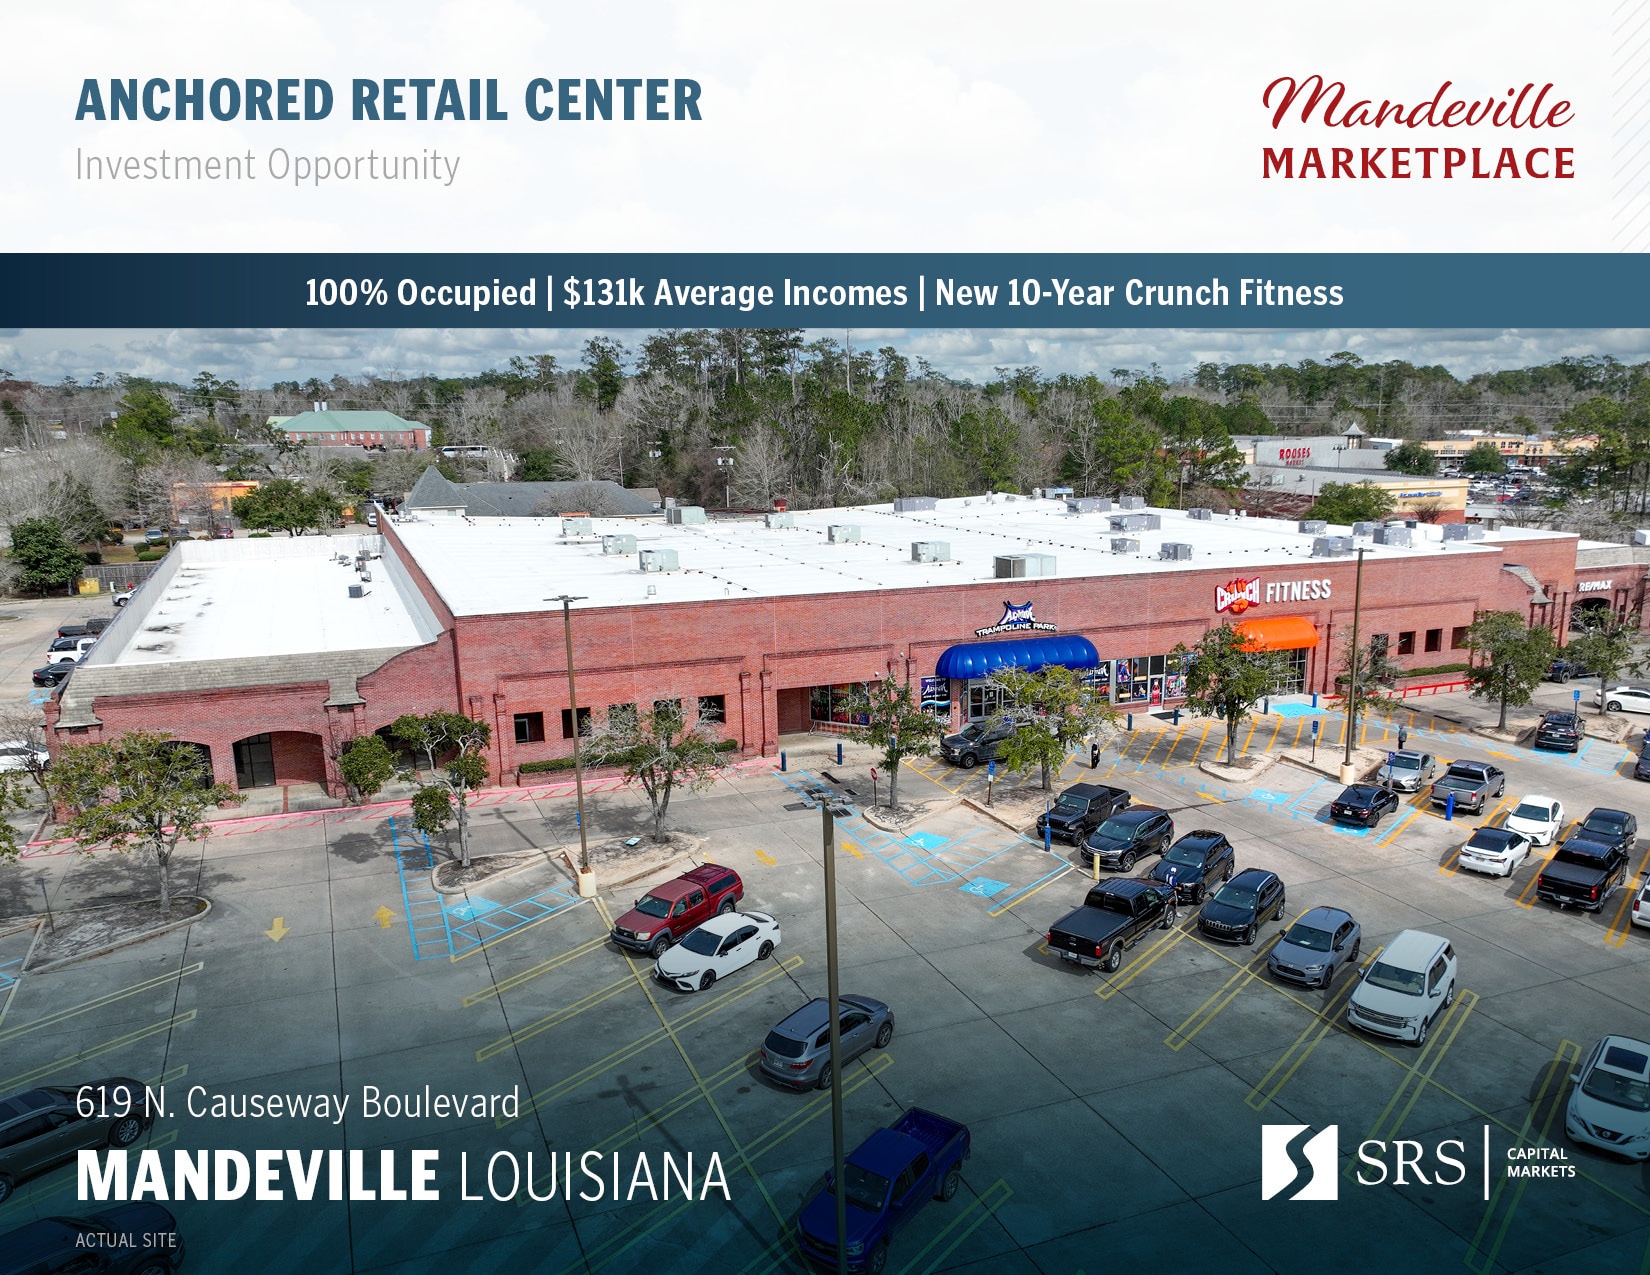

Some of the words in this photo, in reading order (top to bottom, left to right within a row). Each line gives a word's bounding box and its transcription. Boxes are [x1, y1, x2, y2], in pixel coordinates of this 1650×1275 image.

[1278, 447, 1311, 460] ROUSES
[1578, 580, 1613, 592] RE/MAX
[1216, 577, 1260, 612] CRUNCH
[1265, 578, 1332, 603] FITNESS
[976, 623, 1031, 636] TRAMPOLINE
